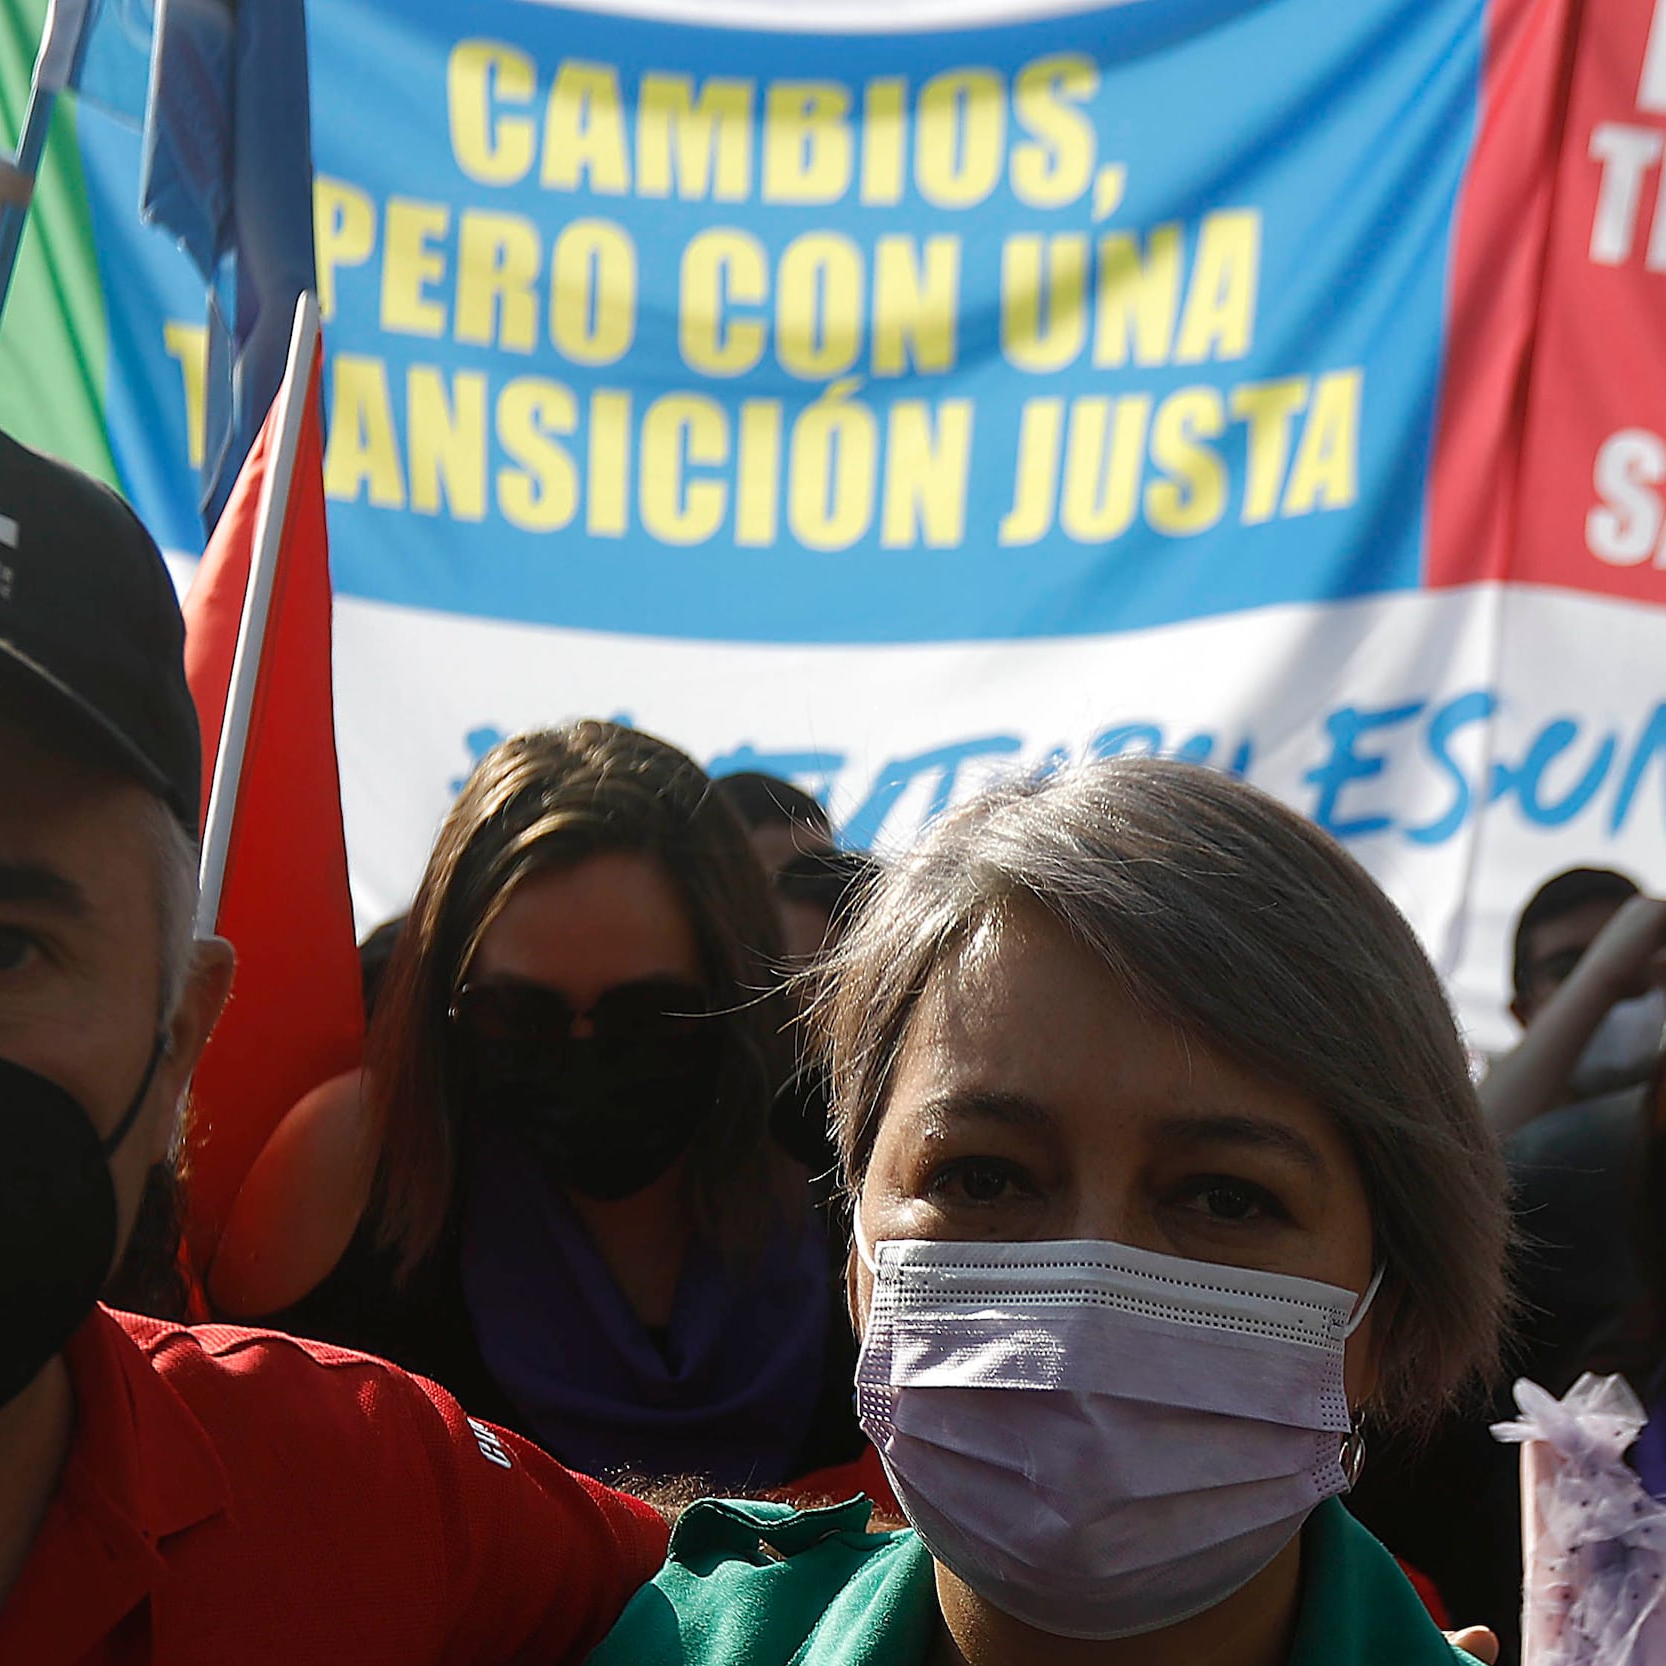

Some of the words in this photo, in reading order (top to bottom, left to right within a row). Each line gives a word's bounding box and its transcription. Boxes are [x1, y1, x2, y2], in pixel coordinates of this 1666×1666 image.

[446, 40, 1127, 223] CAMBIOS,
[311, 172, 640, 366] PERO
[678, 224, 959, 379] CON
[1000, 209, 1263, 374] UNA
[163, 320, 973, 551] TANSICIÓN
[998, 370, 1363, 549] JUSTA
